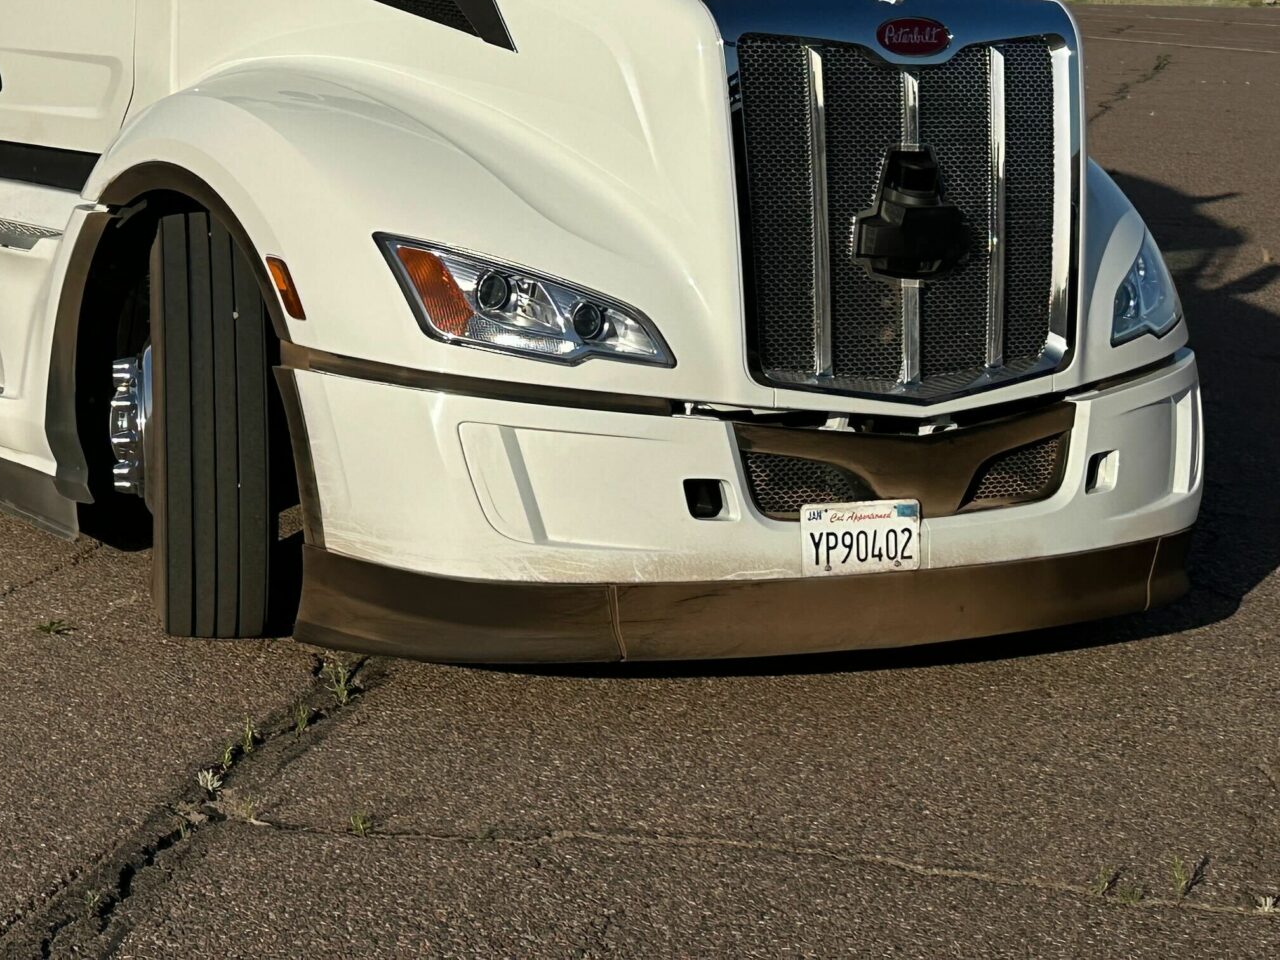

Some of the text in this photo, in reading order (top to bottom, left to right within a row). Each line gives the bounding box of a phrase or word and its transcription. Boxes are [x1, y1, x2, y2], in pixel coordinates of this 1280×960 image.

[884, 24, 942, 46] Peterbilt
[807, 510, 822, 522] JAN
[809, 527, 913, 566] YP90402
